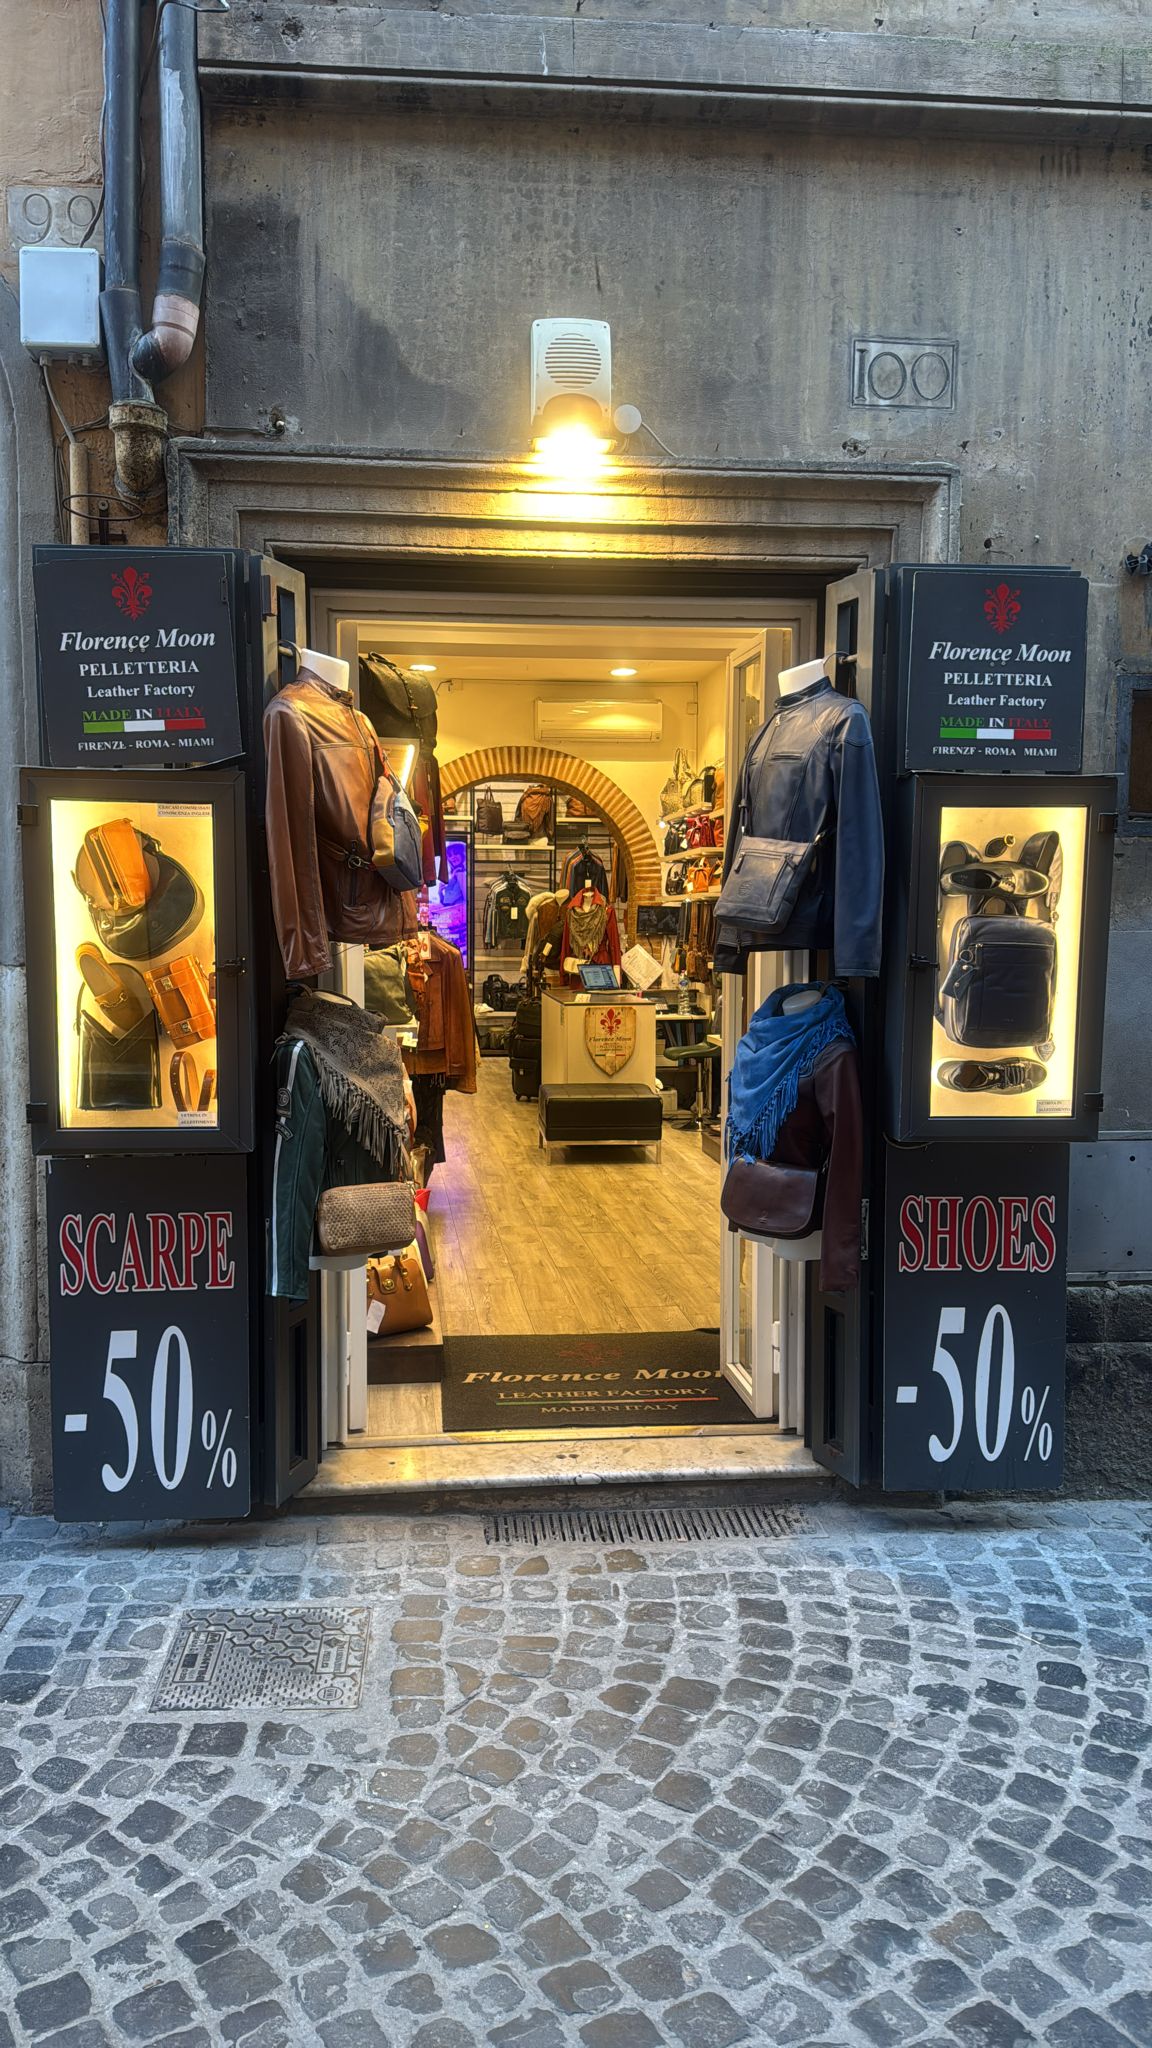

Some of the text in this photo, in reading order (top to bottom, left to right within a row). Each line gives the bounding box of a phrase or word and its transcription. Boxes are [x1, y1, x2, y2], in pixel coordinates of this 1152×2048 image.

[17, 193, 97, 246] 99
[854, 348, 951, 401] 100
[59, 627, 215, 651] Florence Moon
[928, 641, 1072, 663] Florence Moon
[79, 660, 200, 677] PELLETTERIA
[943, 672, 1052, 687] PELLETTERIA
[86, 683, 196, 699] Leather Factory
[948, 693, 1047, 709] Leather Factory
[82, 709, 131, 721] MADE
[135, 708, 153, 719] IN
[940, 717, 985, 727] MADE
[989, 717, 1005, 728] IN
[135, 739, 170, 749] ROMA
[178, 737, 214, 748] MIAMI
[985, 746, 1017, 756] ROMA
[1024, 747, 1057, 757] MIAMI
[898, 1194, 1056, 1273] SHOES
[59, 1211, 235, 1296] SCARPE
[461, 1371, 622, 1384] Florence
[896, 1303, 1053, 1463] -50%
[498, 1388, 709, 1399] LEATHER FACTORY
[64, 1325, 237, 1492] -50%
